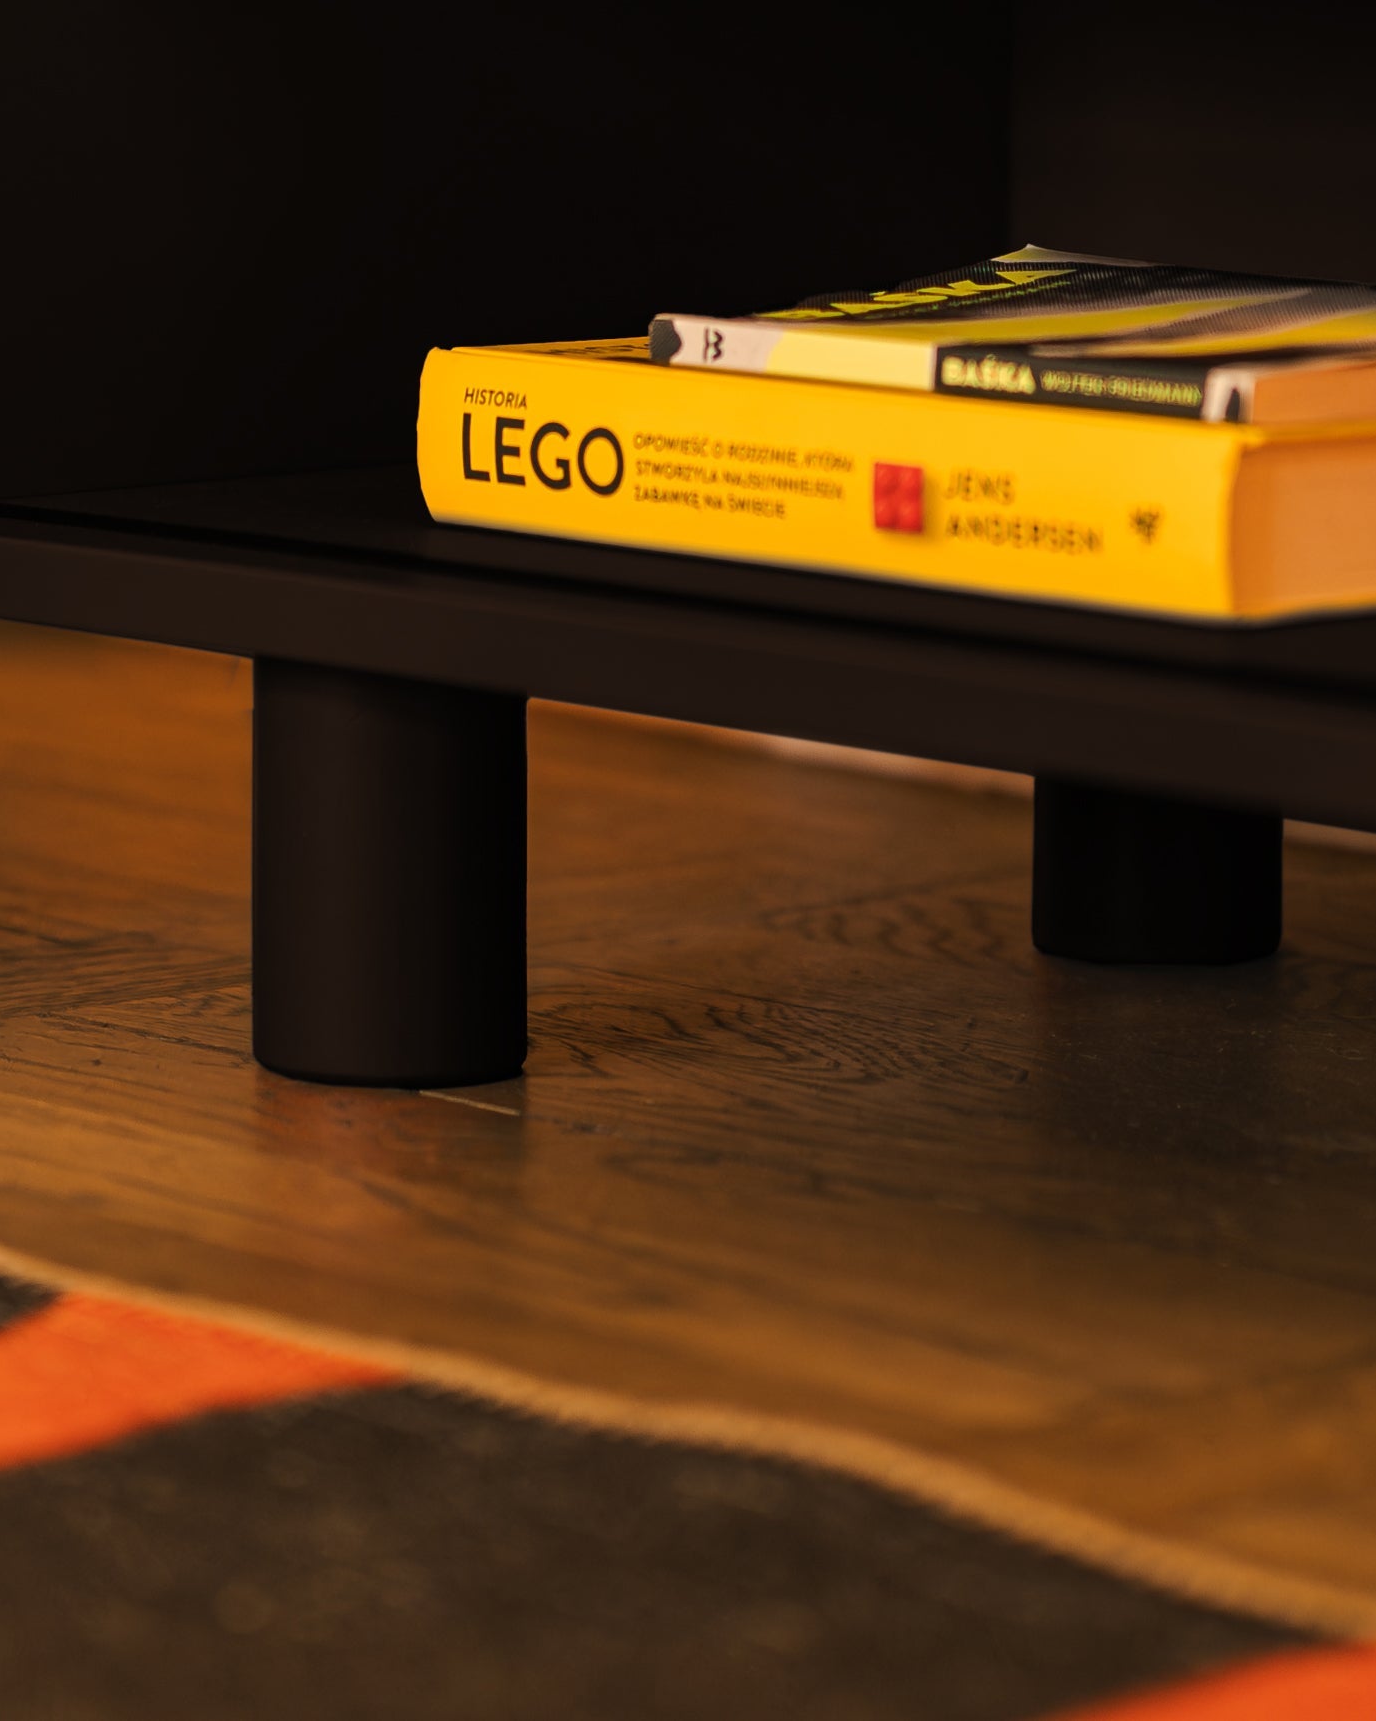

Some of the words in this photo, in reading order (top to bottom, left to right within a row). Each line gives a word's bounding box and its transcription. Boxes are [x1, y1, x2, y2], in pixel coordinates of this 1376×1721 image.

[464, 387, 528, 409] HISTORIA
[462, 412, 625, 497] LEGO
[943, 467, 1018, 505] JENS
[944, 514, 1105, 556] ANDERSEN
